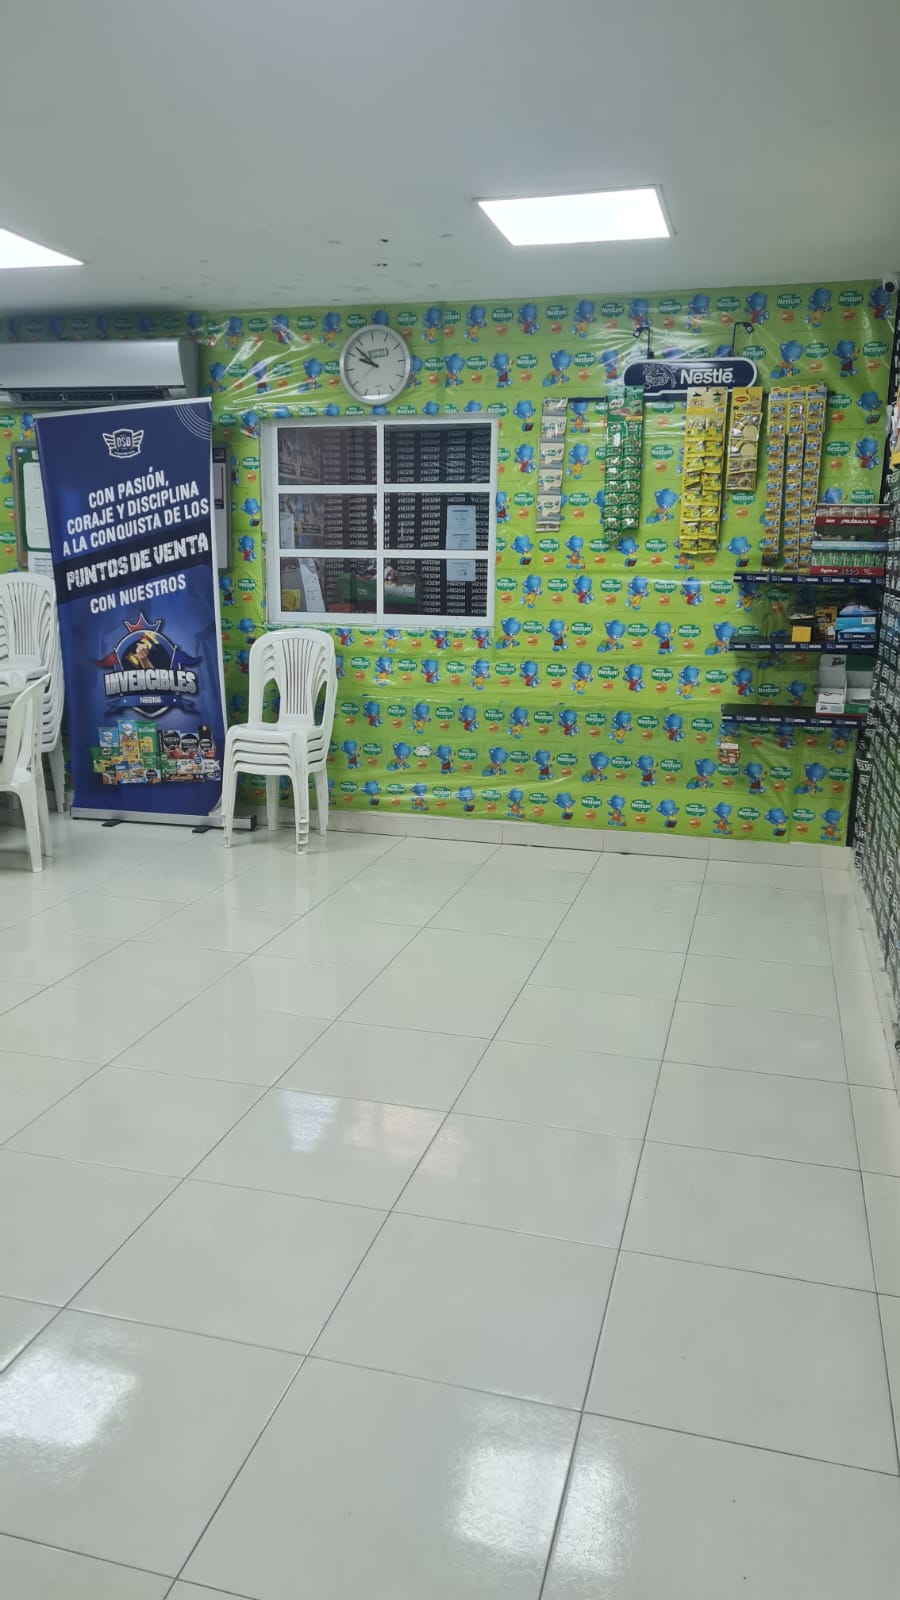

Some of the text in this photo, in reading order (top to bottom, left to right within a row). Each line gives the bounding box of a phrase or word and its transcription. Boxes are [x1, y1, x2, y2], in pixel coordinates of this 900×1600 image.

[680, 368, 733, 384] Nestlé
[67, 480, 199, 535] CORAJE Y DISCIPLINA
[88, 466, 168, 508] CON PASIÓN,
[63, 498, 209, 556] A LA CONQUISTA DE LOS
[66, 532, 209, 590] PUNTOS DE VENTA
[90, 574, 186, 614] CON NUESTROS
[105, 669, 197, 695] INVENCIBLES
